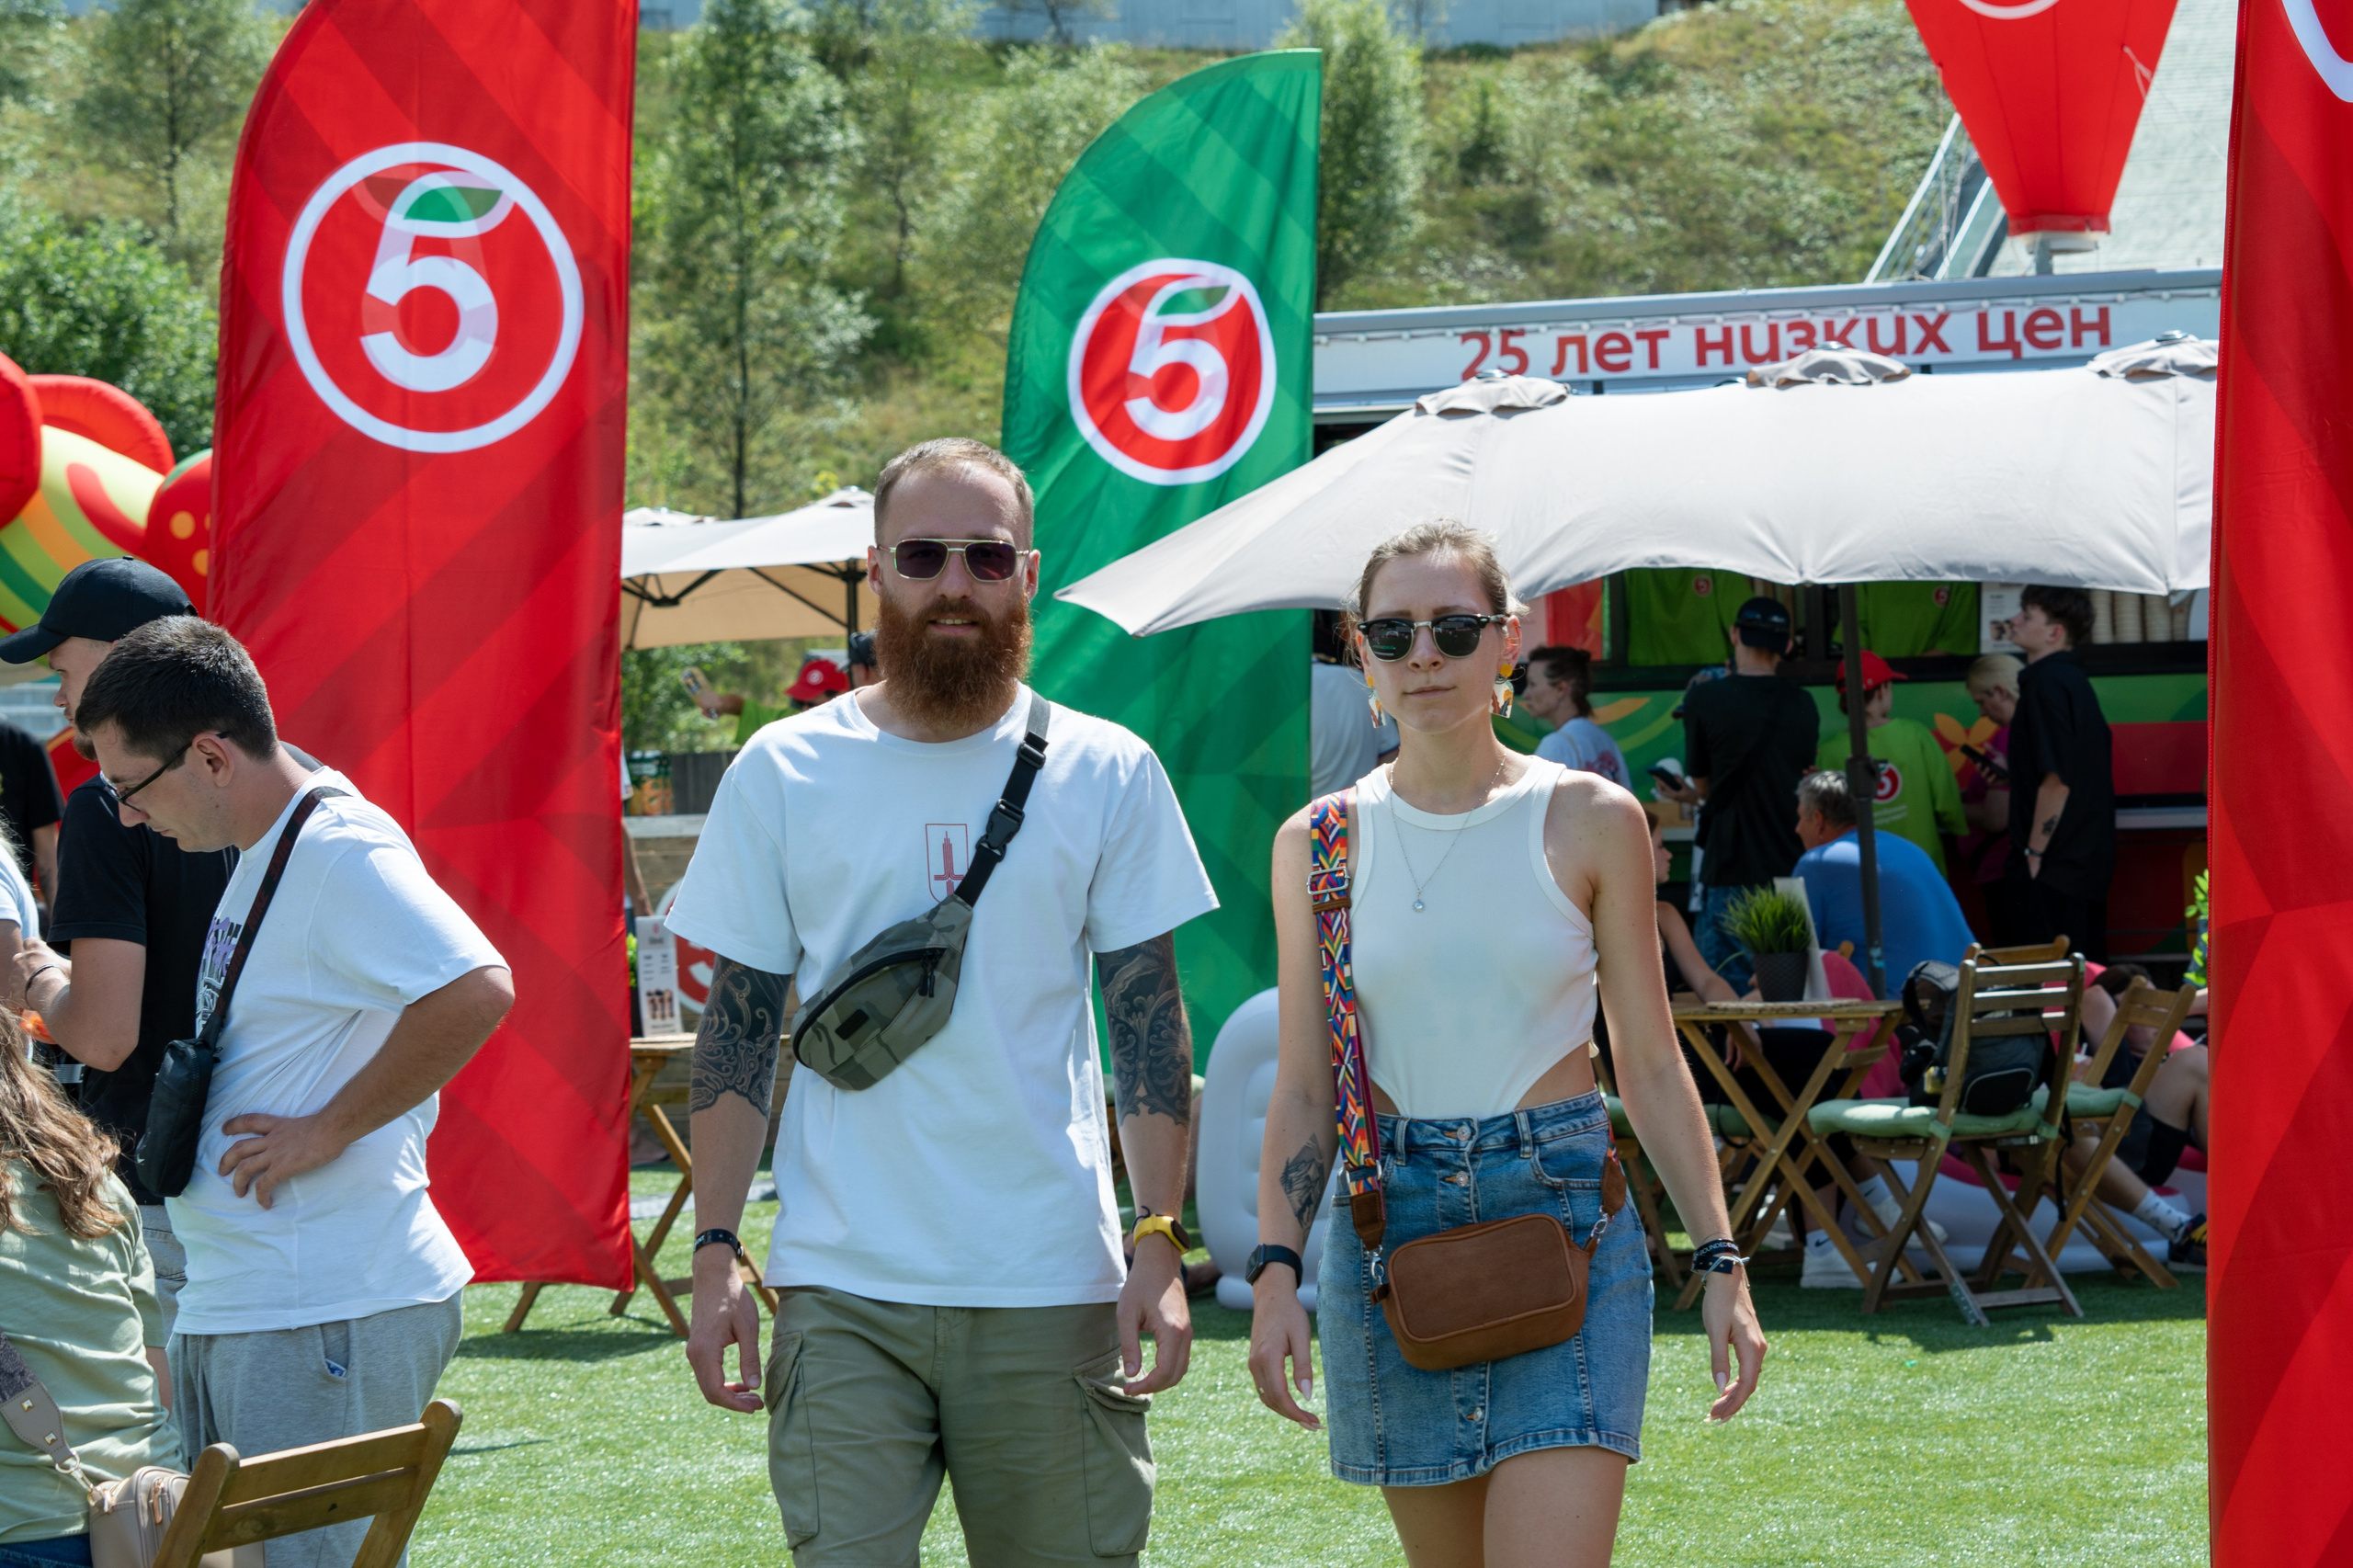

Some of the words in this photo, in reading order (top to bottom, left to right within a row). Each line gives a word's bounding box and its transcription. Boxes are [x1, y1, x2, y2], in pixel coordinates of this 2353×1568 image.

[1460, 327, 1529, 381] 25
[1551, 329, 1671, 376] лет
[1694, 311, 1953, 367] низких
[1976, 305, 2111, 359] цен
